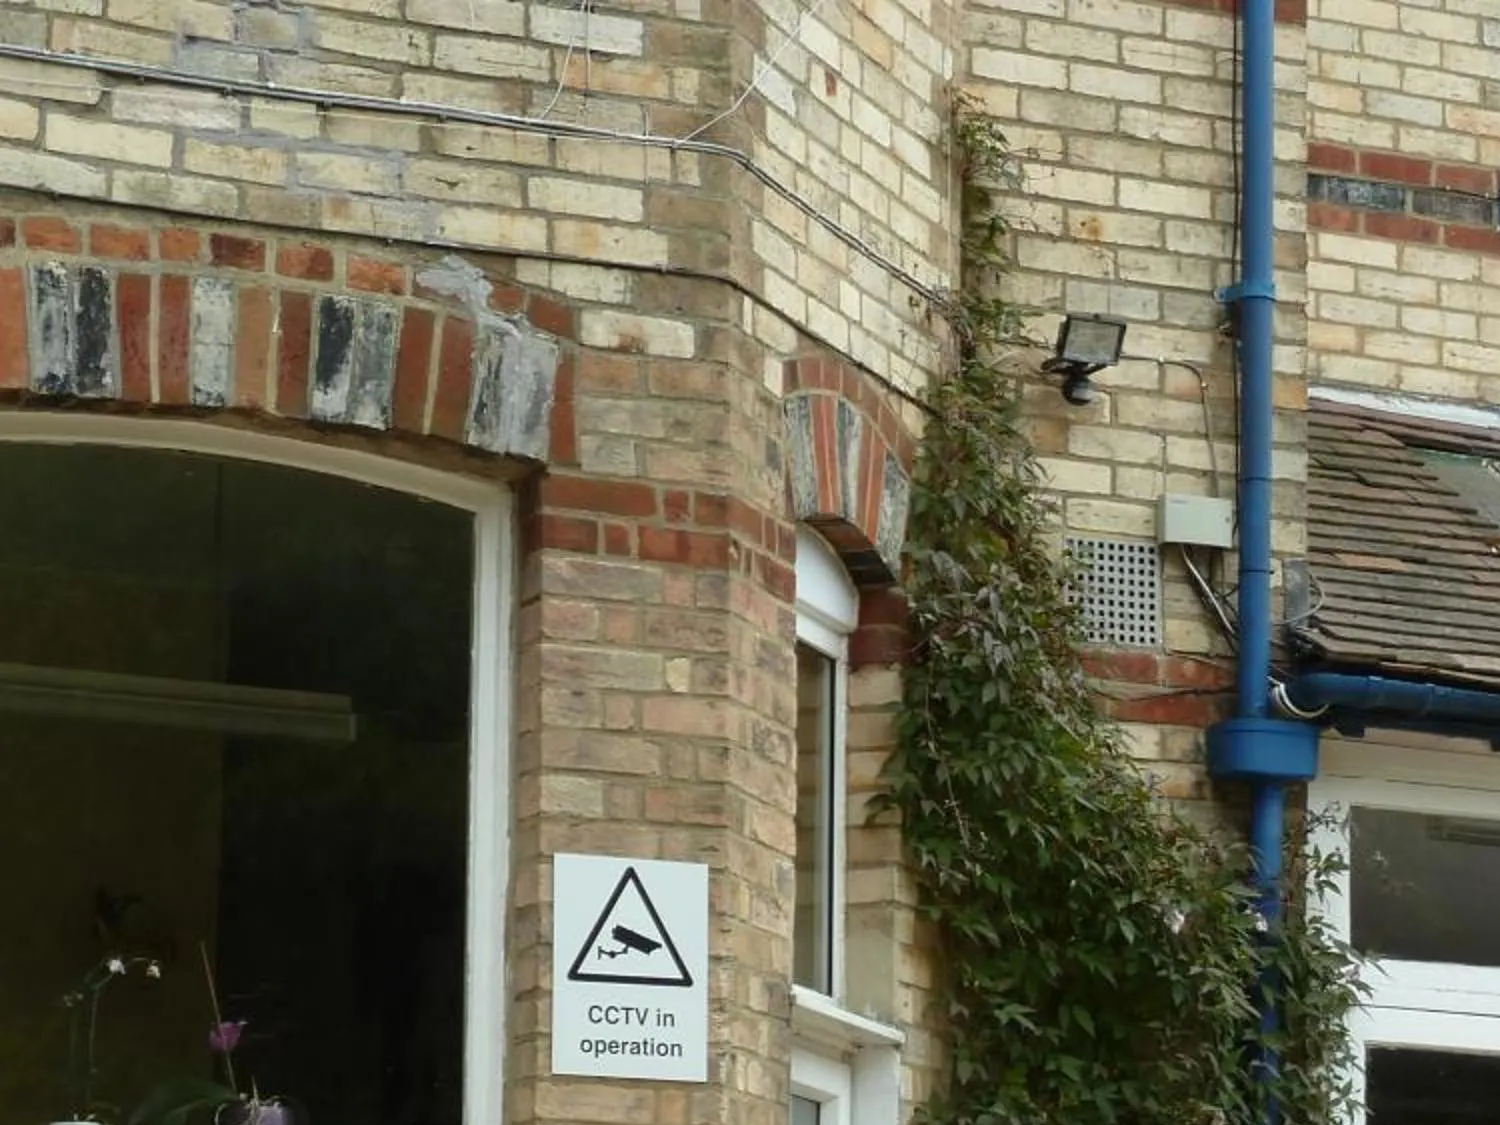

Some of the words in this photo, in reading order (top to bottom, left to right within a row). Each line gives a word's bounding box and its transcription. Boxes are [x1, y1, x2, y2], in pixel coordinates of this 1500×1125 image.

[588, 1005, 649, 1025] CCTV
[656, 1009, 675, 1027] in
[580, 1039, 682, 1058] operation
